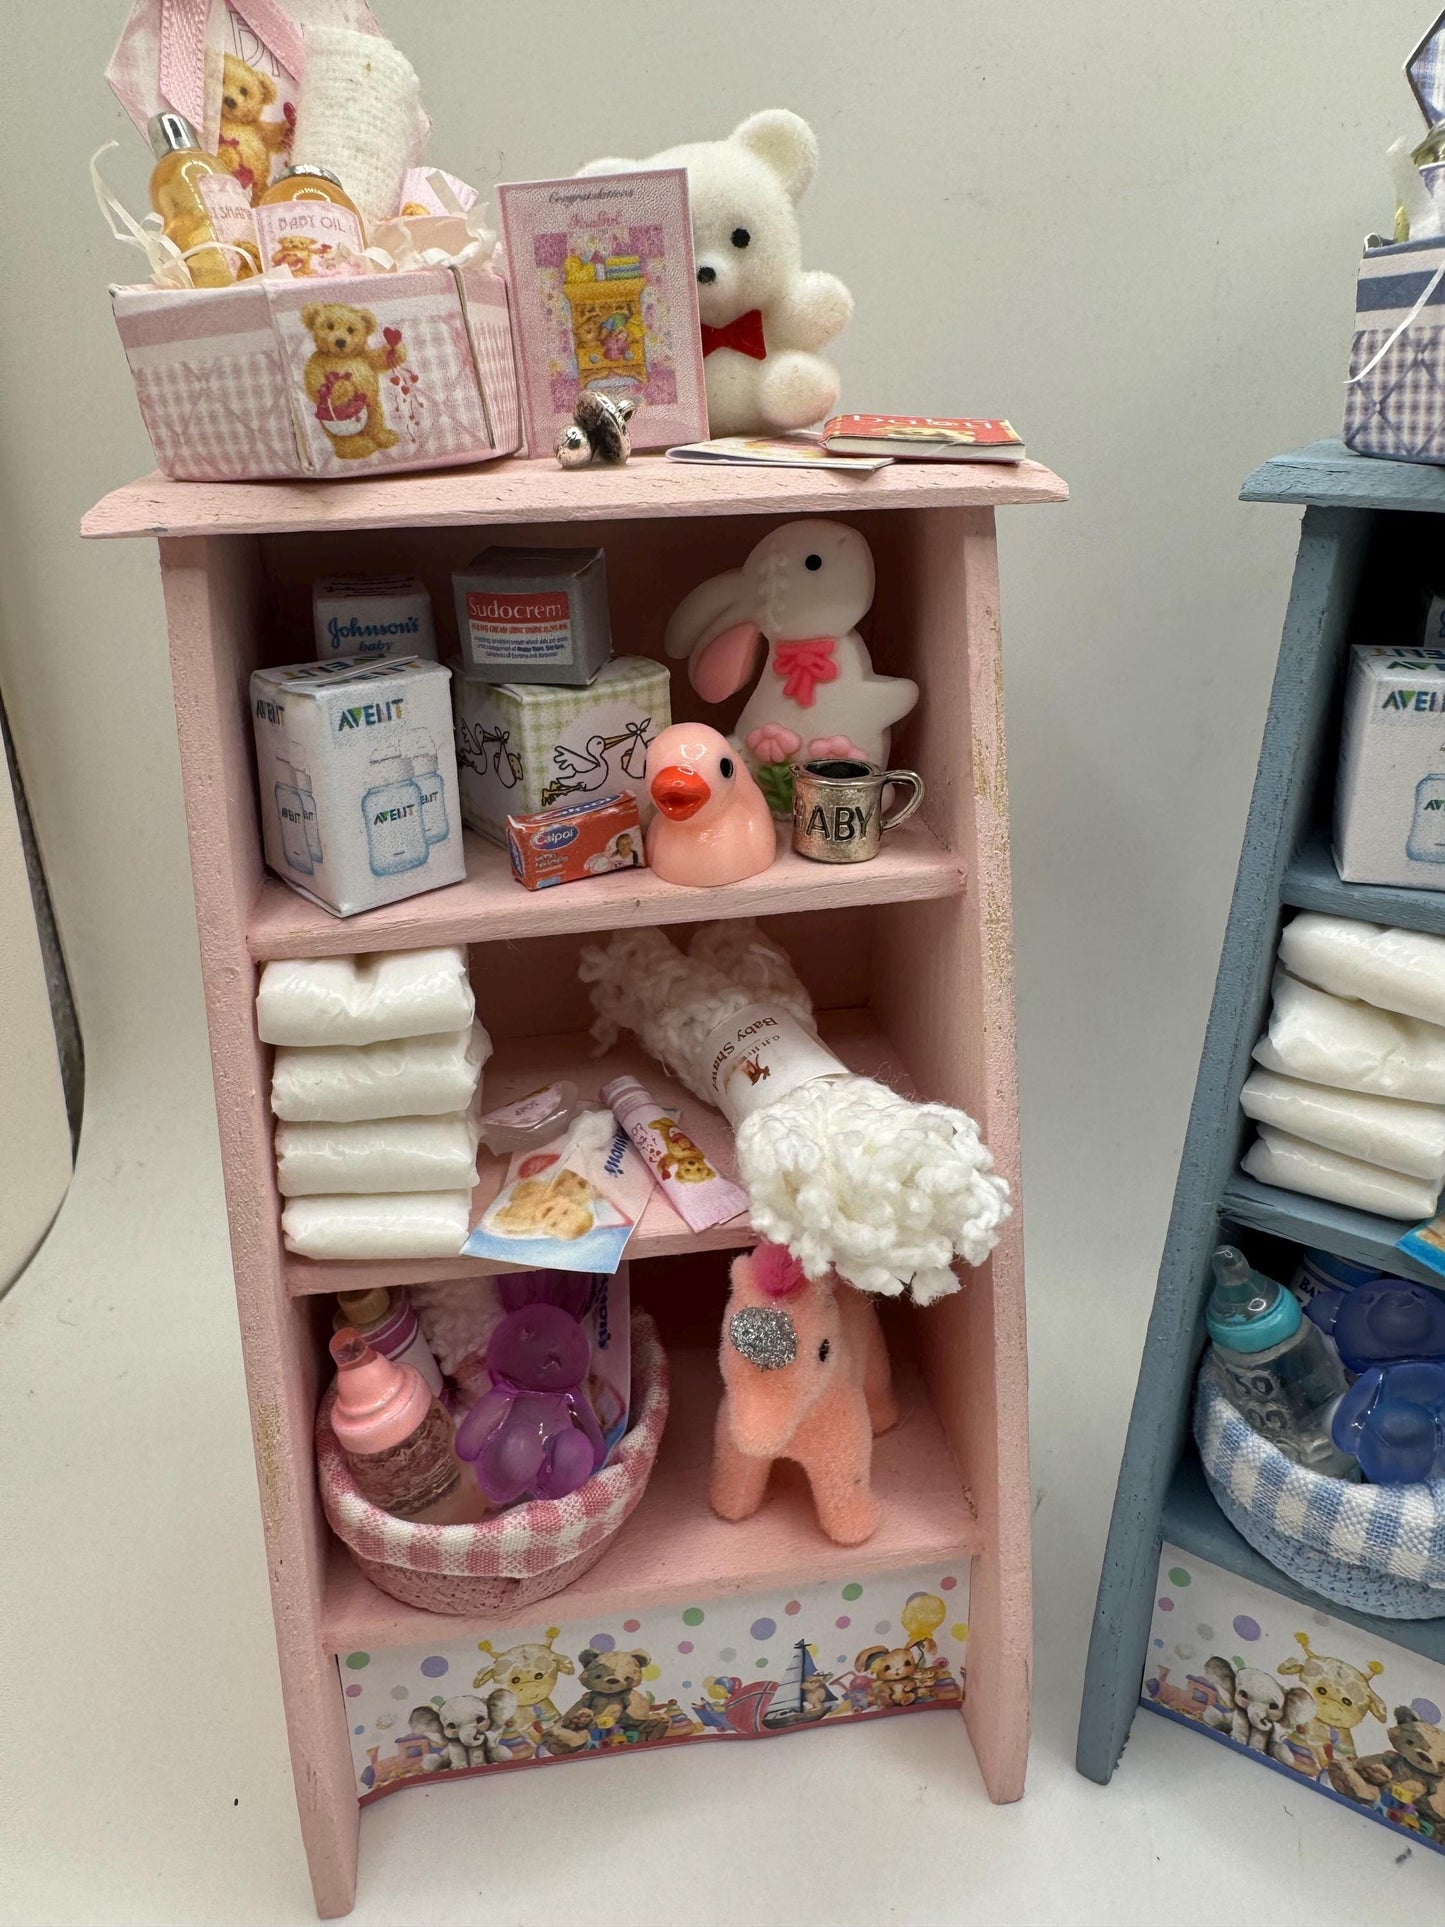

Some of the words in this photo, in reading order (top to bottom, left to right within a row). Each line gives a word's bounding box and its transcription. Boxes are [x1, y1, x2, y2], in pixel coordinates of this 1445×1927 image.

[320, 216, 347, 232] OIL
[468, 598, 562, 619] Sudocrem
[328, 617, 420, 649] Johnson's
[338, 699, 404, 732] AVENT
[737, 1017, 779, 1042] Baby
